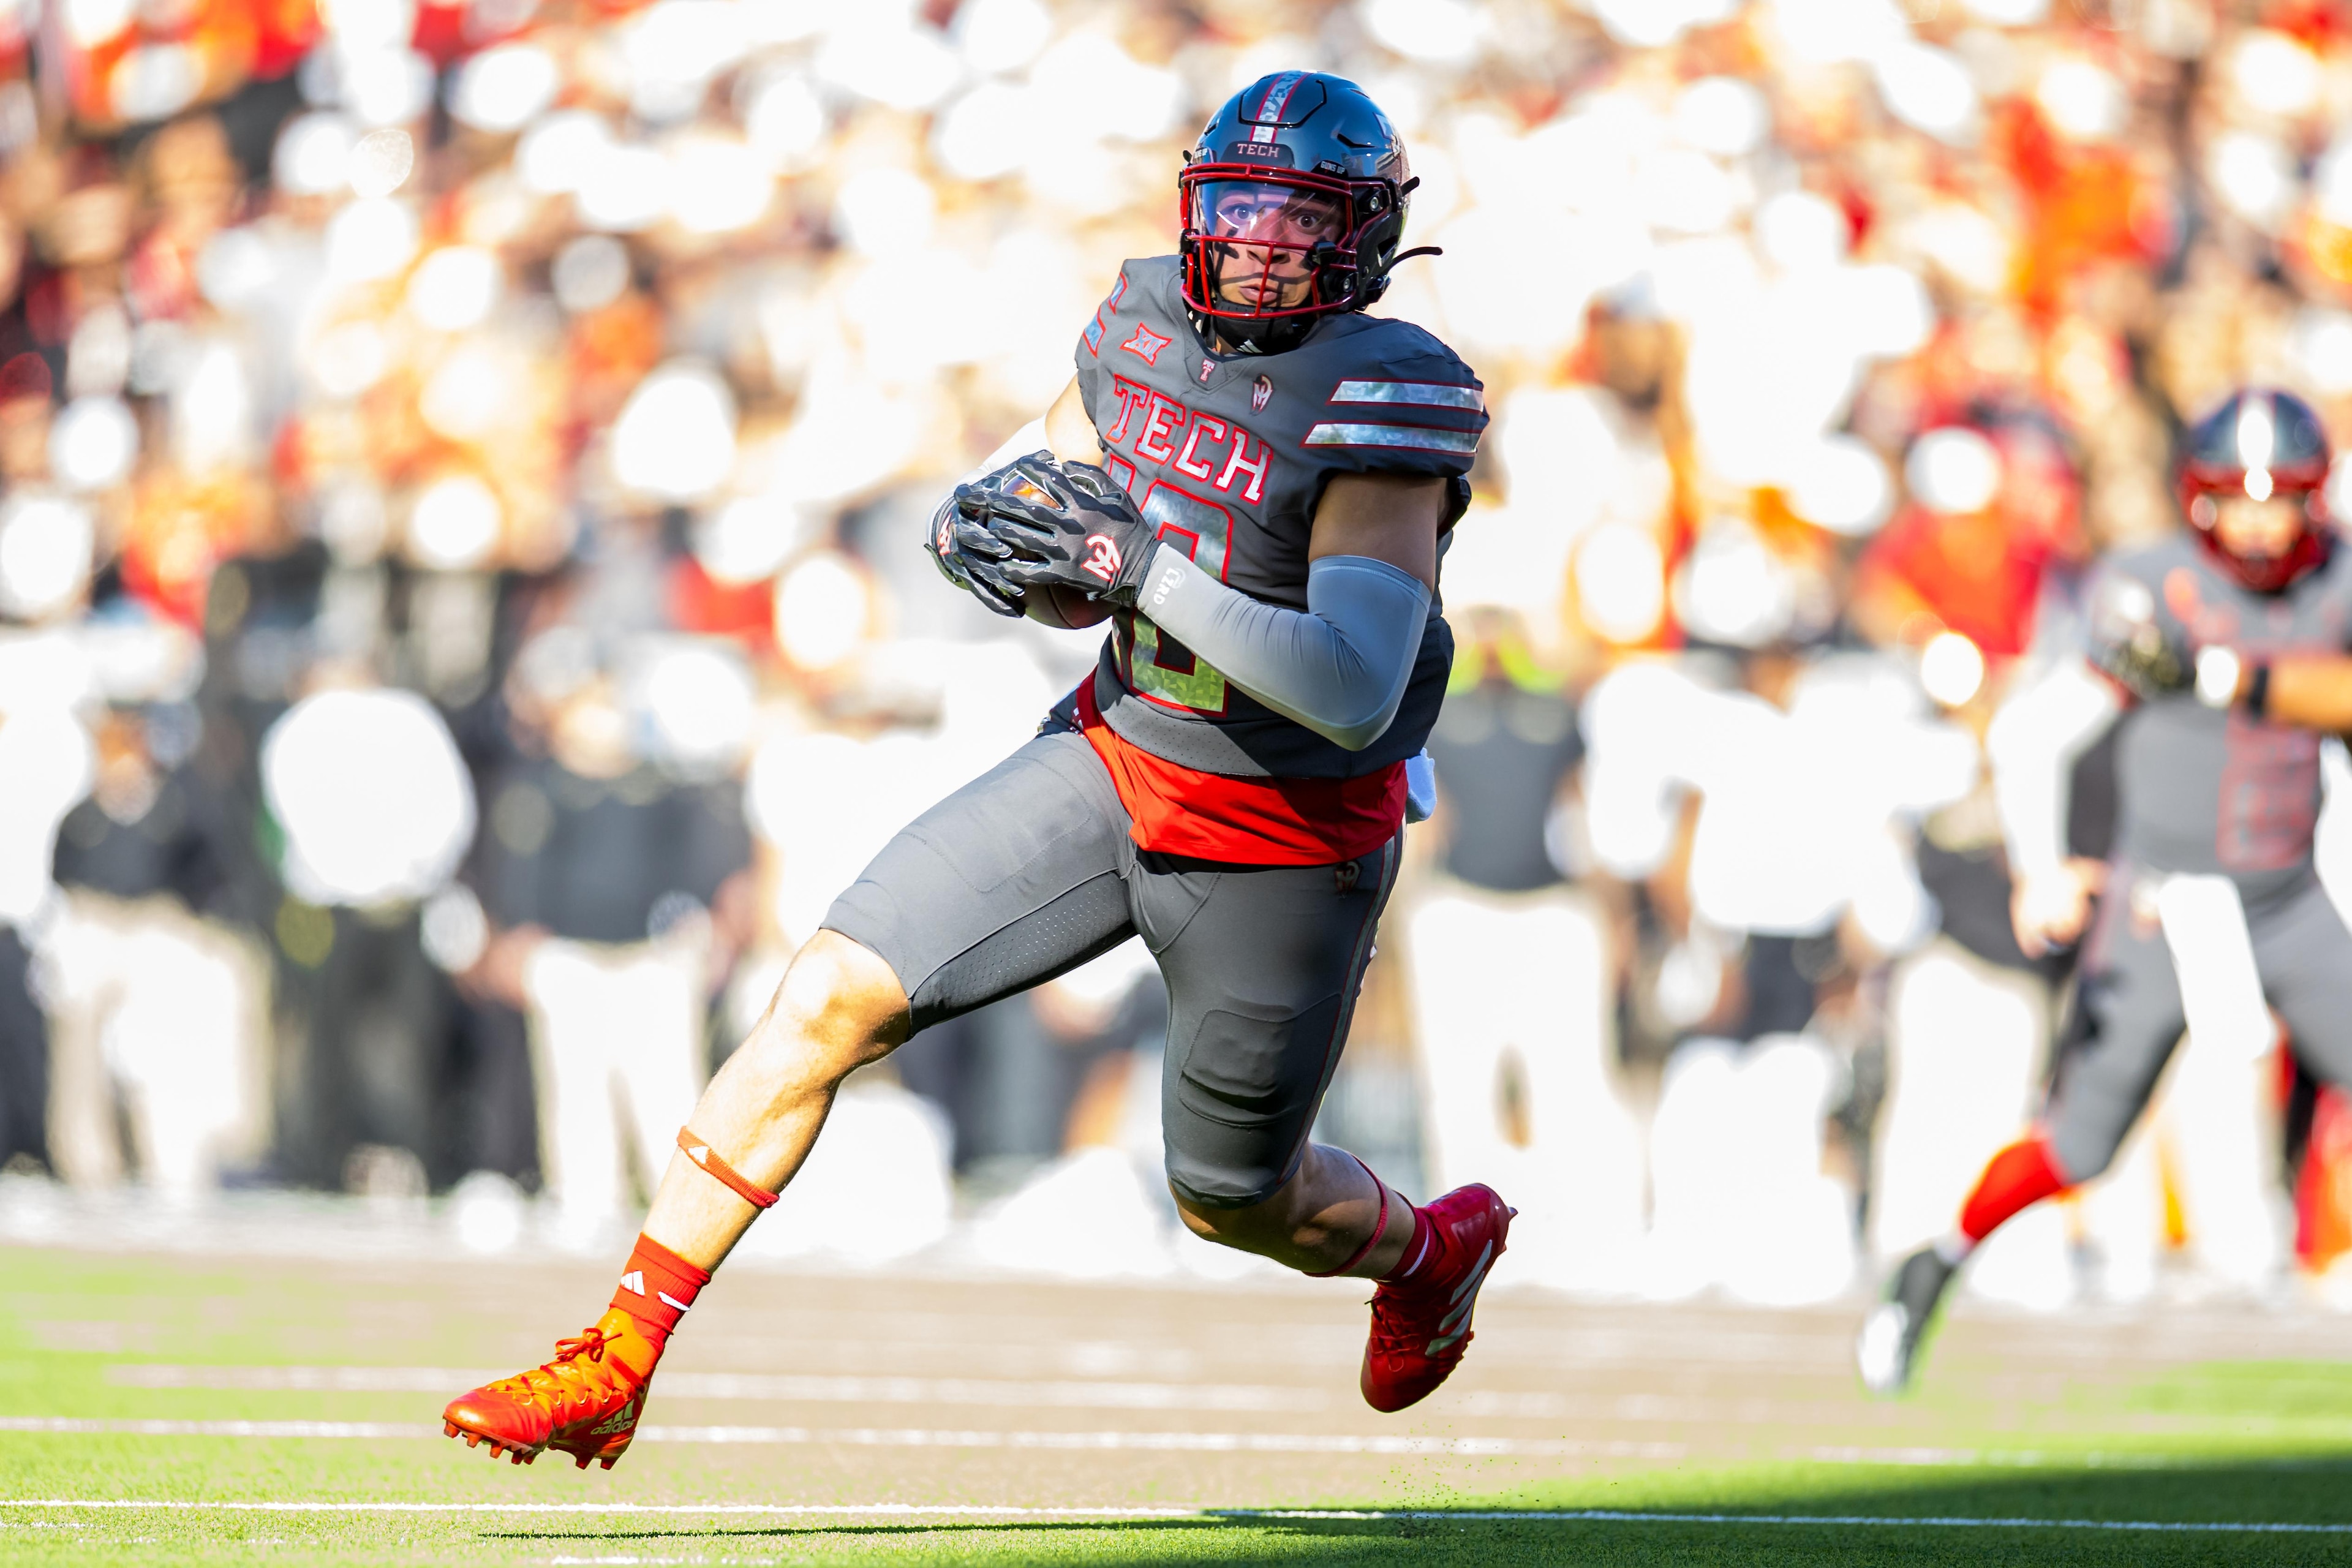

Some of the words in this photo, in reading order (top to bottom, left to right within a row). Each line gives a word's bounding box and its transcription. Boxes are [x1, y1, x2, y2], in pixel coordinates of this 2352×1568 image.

[1237, 143, 1280, 157] TECH
[1321, 160, 1336, 172] GUNS
[1336, 165, 1346, 175] UP
[1105, 373, 1273, 506] TECH
[1153, 568, 1180, 605] LZRD
[590, 1419, 636, 1434] adidas
